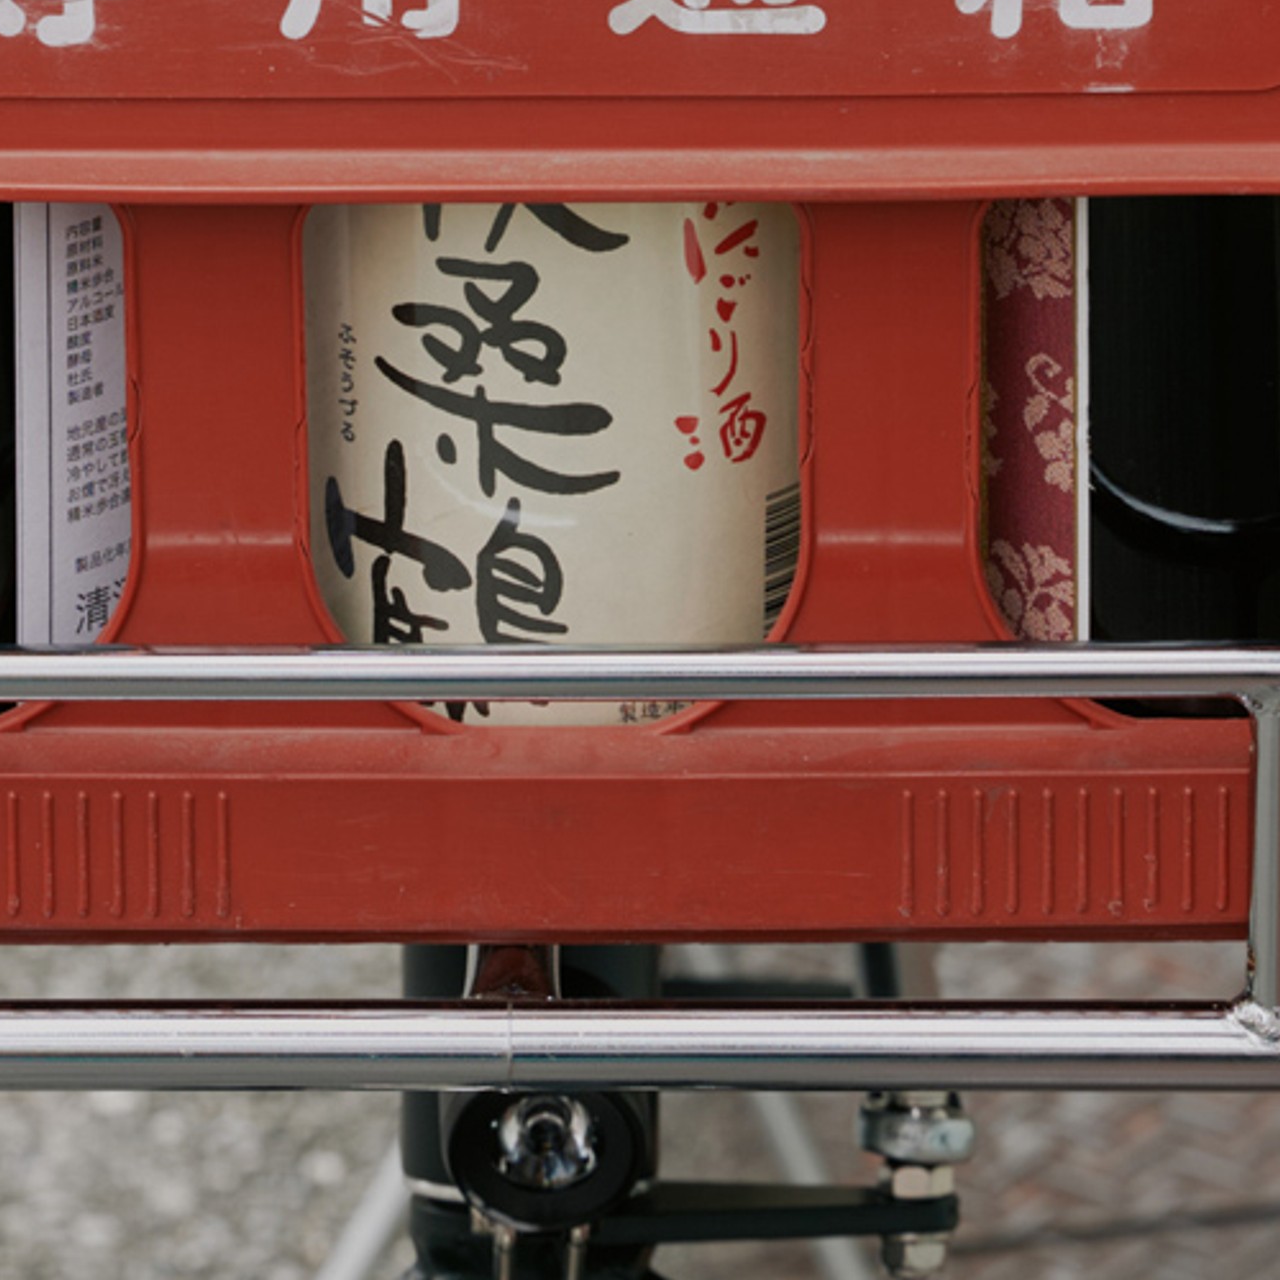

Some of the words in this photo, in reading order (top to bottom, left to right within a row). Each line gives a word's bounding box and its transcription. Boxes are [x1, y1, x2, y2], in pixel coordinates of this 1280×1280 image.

[67, 267, 114, 296] 精米歩合
[67, 304, 115, 332] 日本酒度
[76, 538, 131, 573] 製品化年
